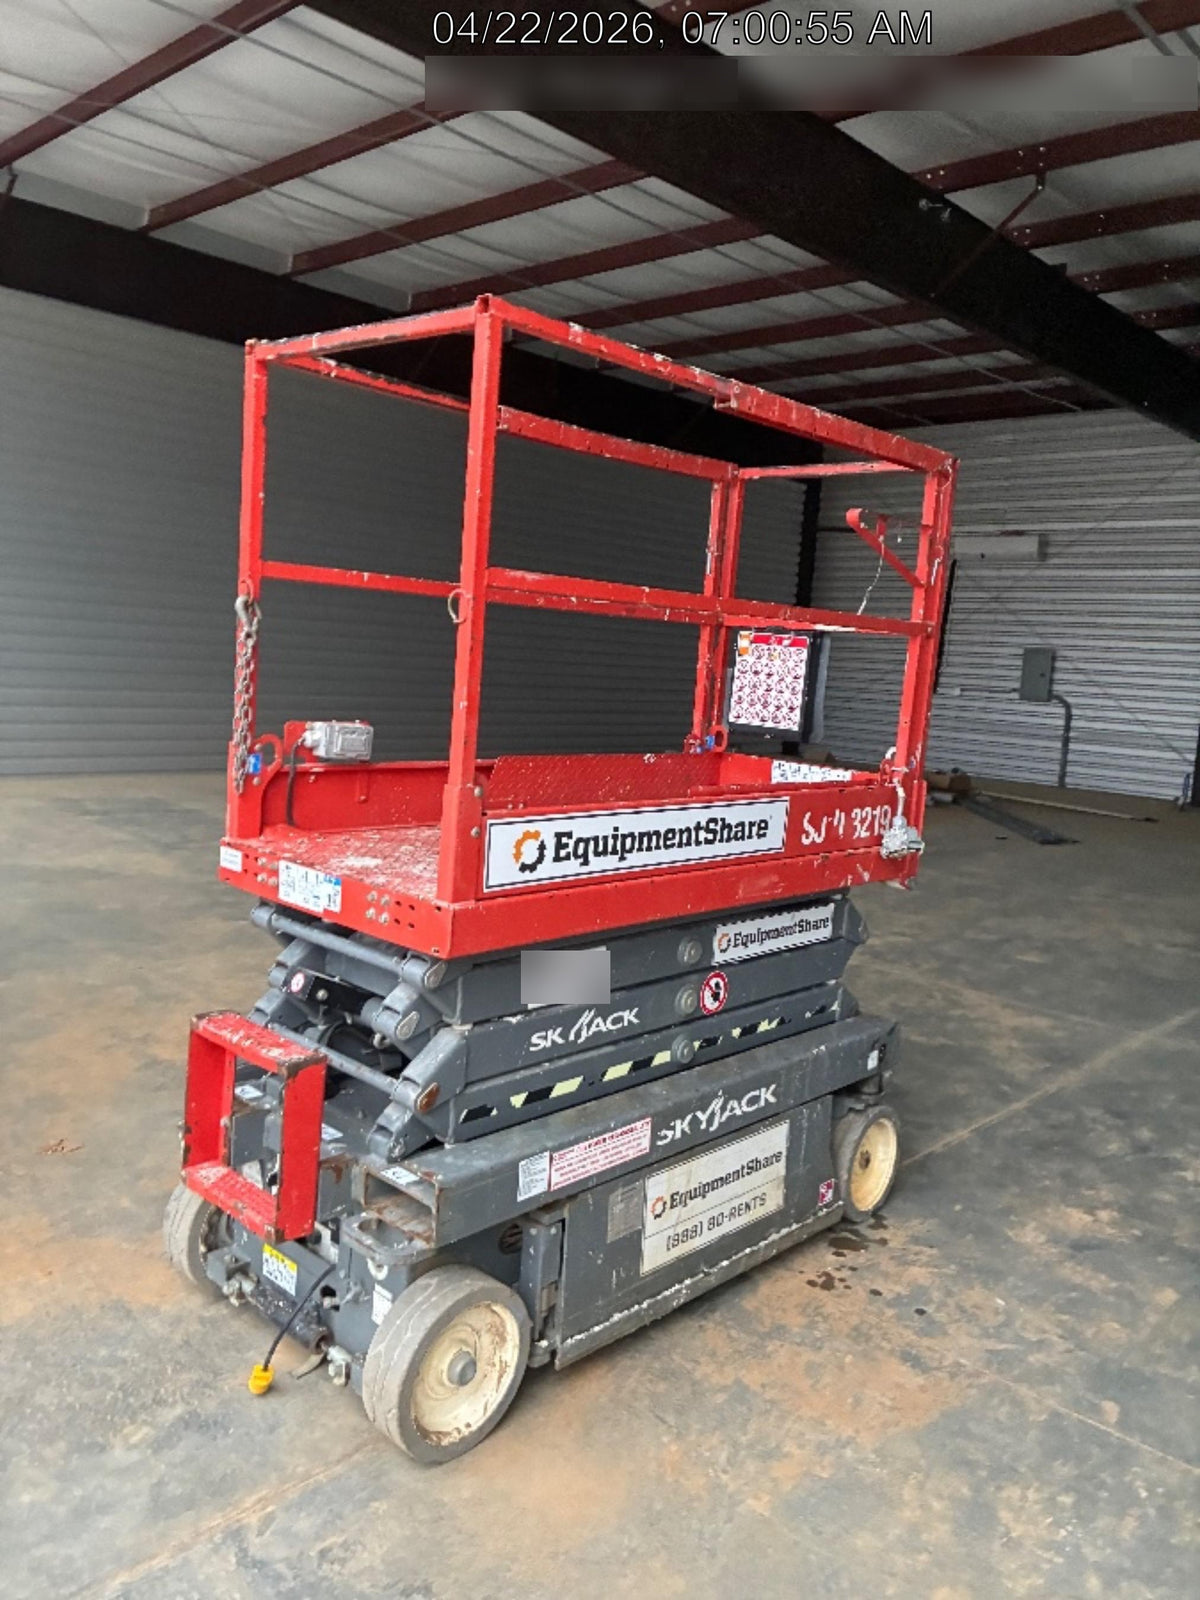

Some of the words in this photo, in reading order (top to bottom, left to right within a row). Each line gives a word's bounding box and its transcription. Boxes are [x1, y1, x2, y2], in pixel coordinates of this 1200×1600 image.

[552, 817, 769, 866] EquipmentShare
[732, 917, 829, 949] EquipmentShare
[656, 1084, 778, 1146] SKYJACK
[669, 1151, 783, 1209] EquipmentShare
